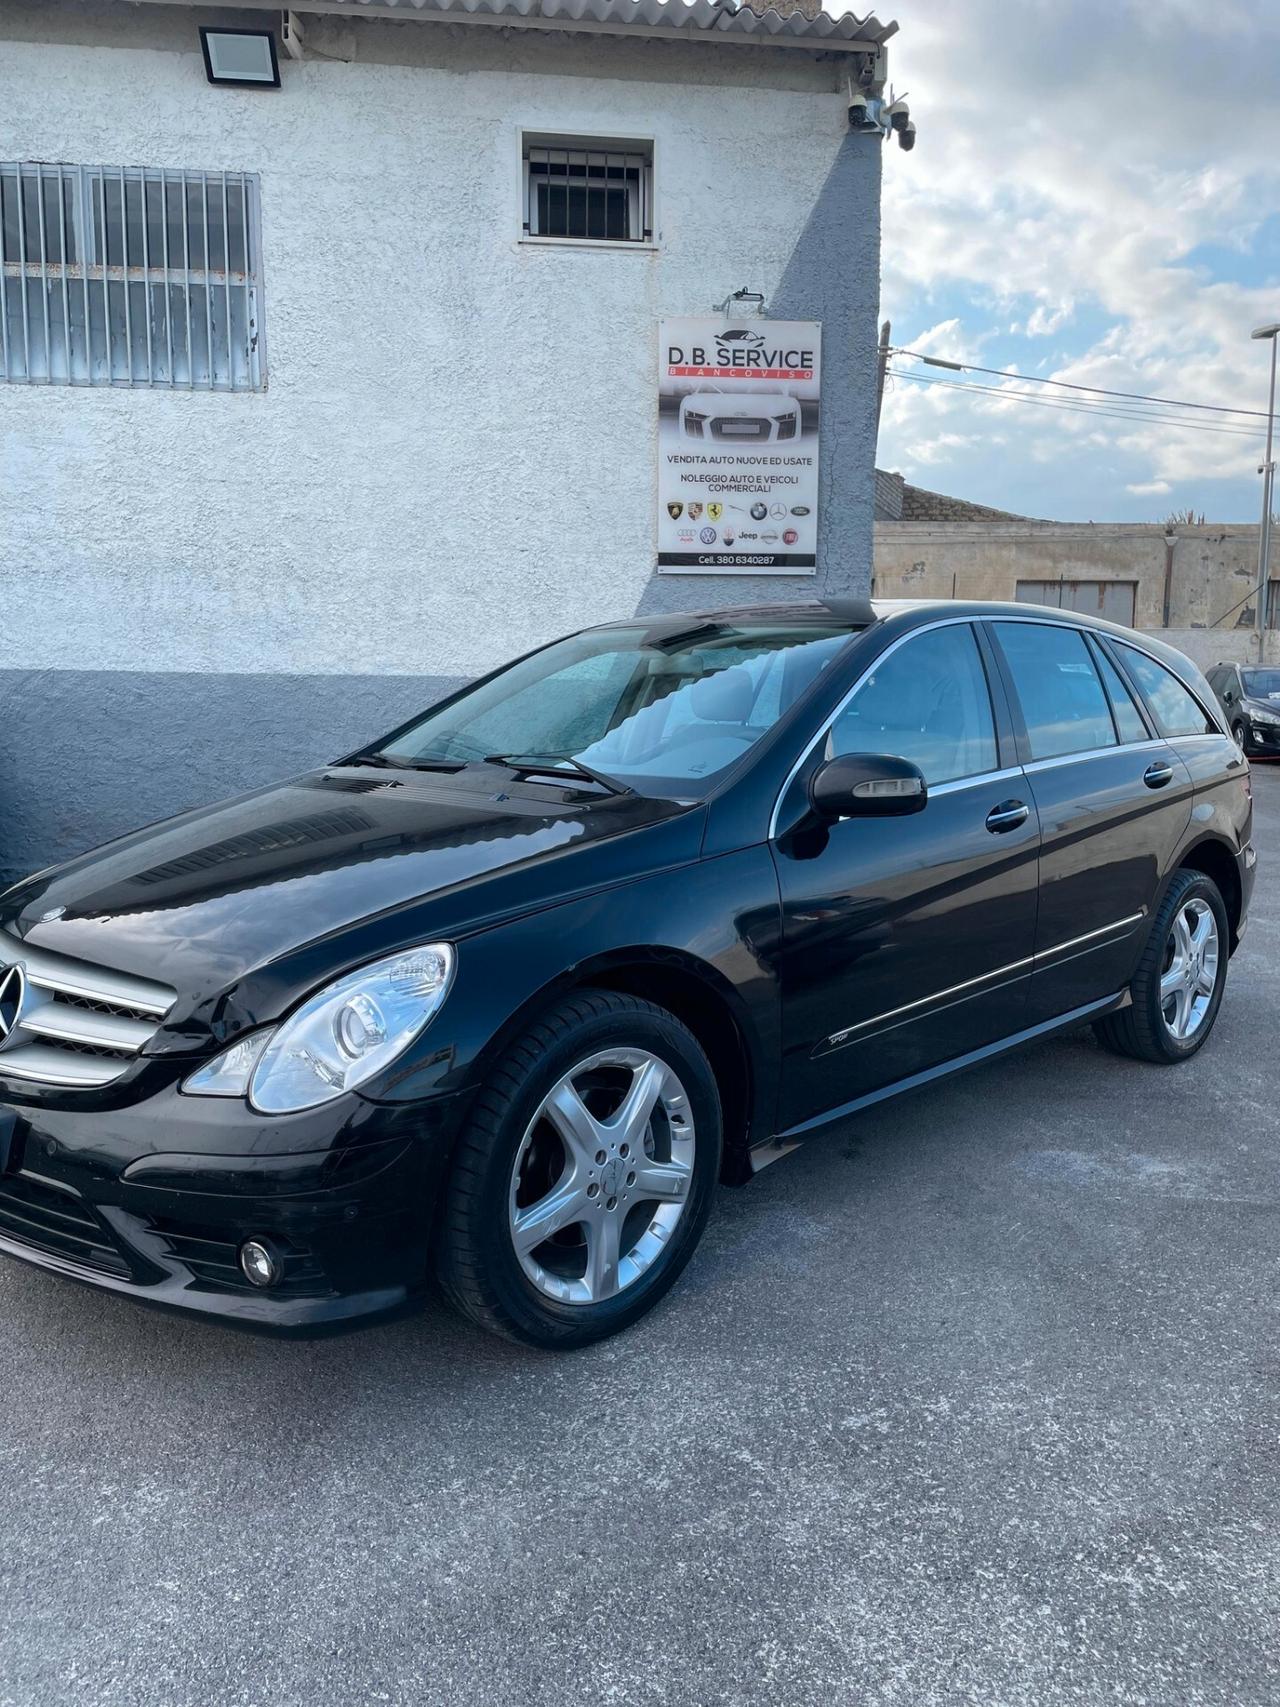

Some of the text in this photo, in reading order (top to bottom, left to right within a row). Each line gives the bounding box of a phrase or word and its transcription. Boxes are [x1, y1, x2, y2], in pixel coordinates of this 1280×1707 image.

[669, 347, 813, 369] D.B. SERVICE
[670, 368, 811, 378] BIANCOVISO
[667, 455, 813, 466] VENDITA AUTO NUOVE ED USATE
[680, 474, 798, 484] NOLEGGIO AUTO E VEICOLI
[708, 484, 771, 493] COMMERCIALI
[738, 531, 758, 541] Jeep
[698, 555, 775, 565] Cell. 380 6340287
